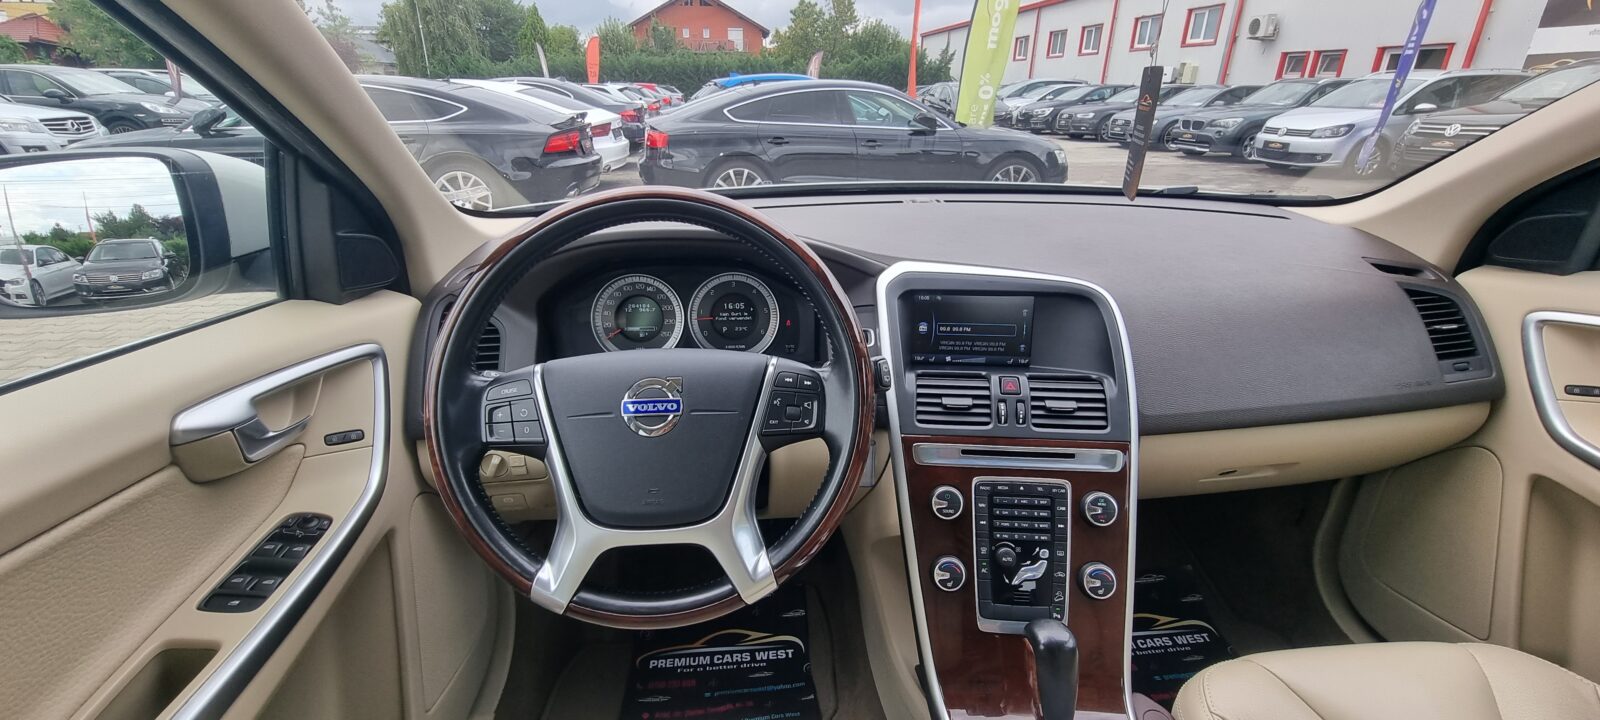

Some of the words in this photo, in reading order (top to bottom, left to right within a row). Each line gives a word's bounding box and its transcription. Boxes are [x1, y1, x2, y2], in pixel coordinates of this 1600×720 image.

[979, 72, 994, 100] 0%
[500, 387, 518, 395] CRUISE
[625, 402, 678, 412] VOLVO
[1137, 637, 1173, 649] CARS
[1173, 633, 1211, 645] WEST
[1136, 647, 1165, 656] better
[649, 655, 711, 669] PREMIUM
[713, 652, 751, 664] CARS
[755, 649, 795, 661] WEST
